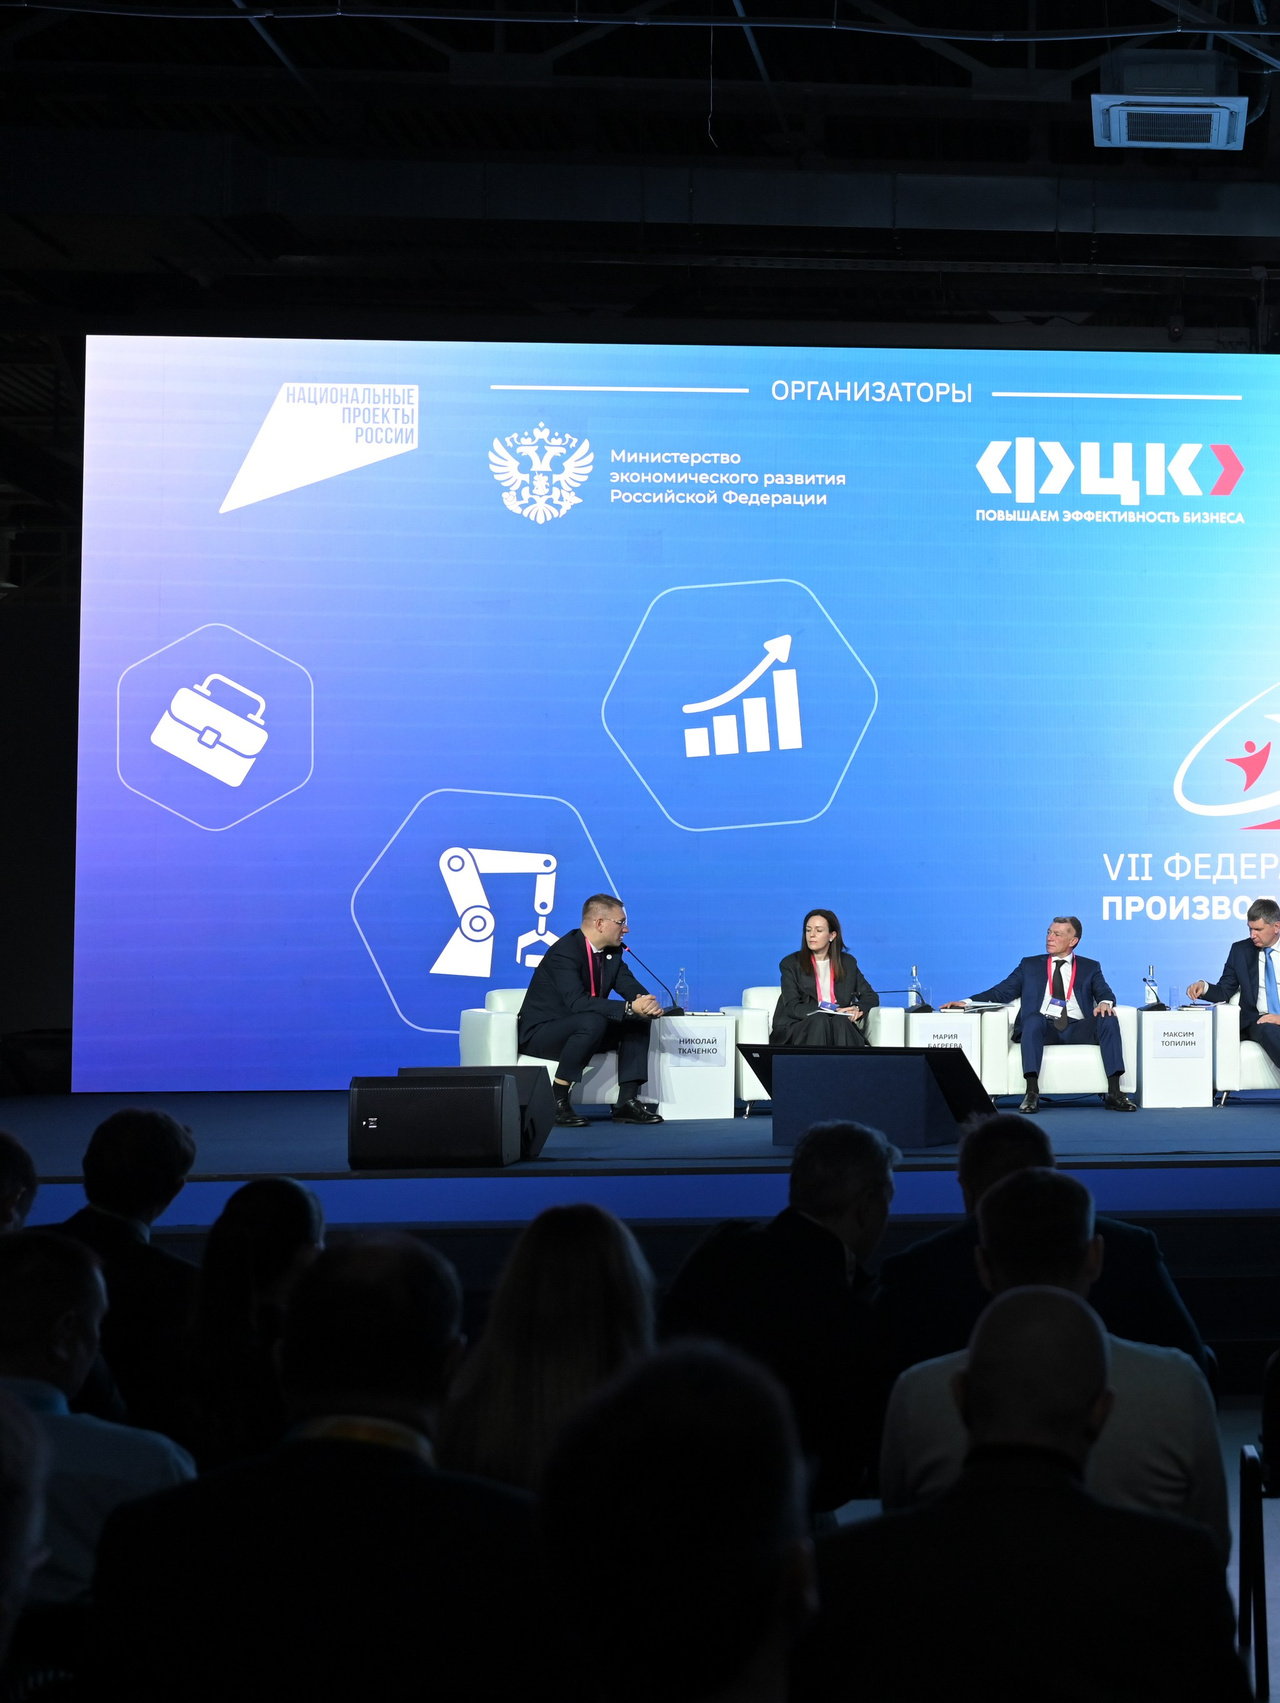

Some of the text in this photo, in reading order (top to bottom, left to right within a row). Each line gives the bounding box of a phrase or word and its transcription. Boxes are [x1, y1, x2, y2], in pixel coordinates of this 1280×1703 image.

[286, 386, 415, 405] НАЦИОНАЛЬНЫЕ
[771, 380, 972, 403] ОРГАНИЗАТОРЫ
[342, 407, 414, 424] ПРОЕКТЫ
[355, 427, 414, 444] РОССИИ
[610, 449, 741, 466] Министерство
[609, 470, 847, 487] экономического развития
[610, 489, 827, 507] Российской Федерации
[976, 509, 1245, 524] ПОВЫШАЕМ ЭФФЕКТИВНОСТЬ БИЗНЕСА
[1102, 853, 1153, 881] VII
[679, 1037, 717, 1045] НИКОЛАЙ
